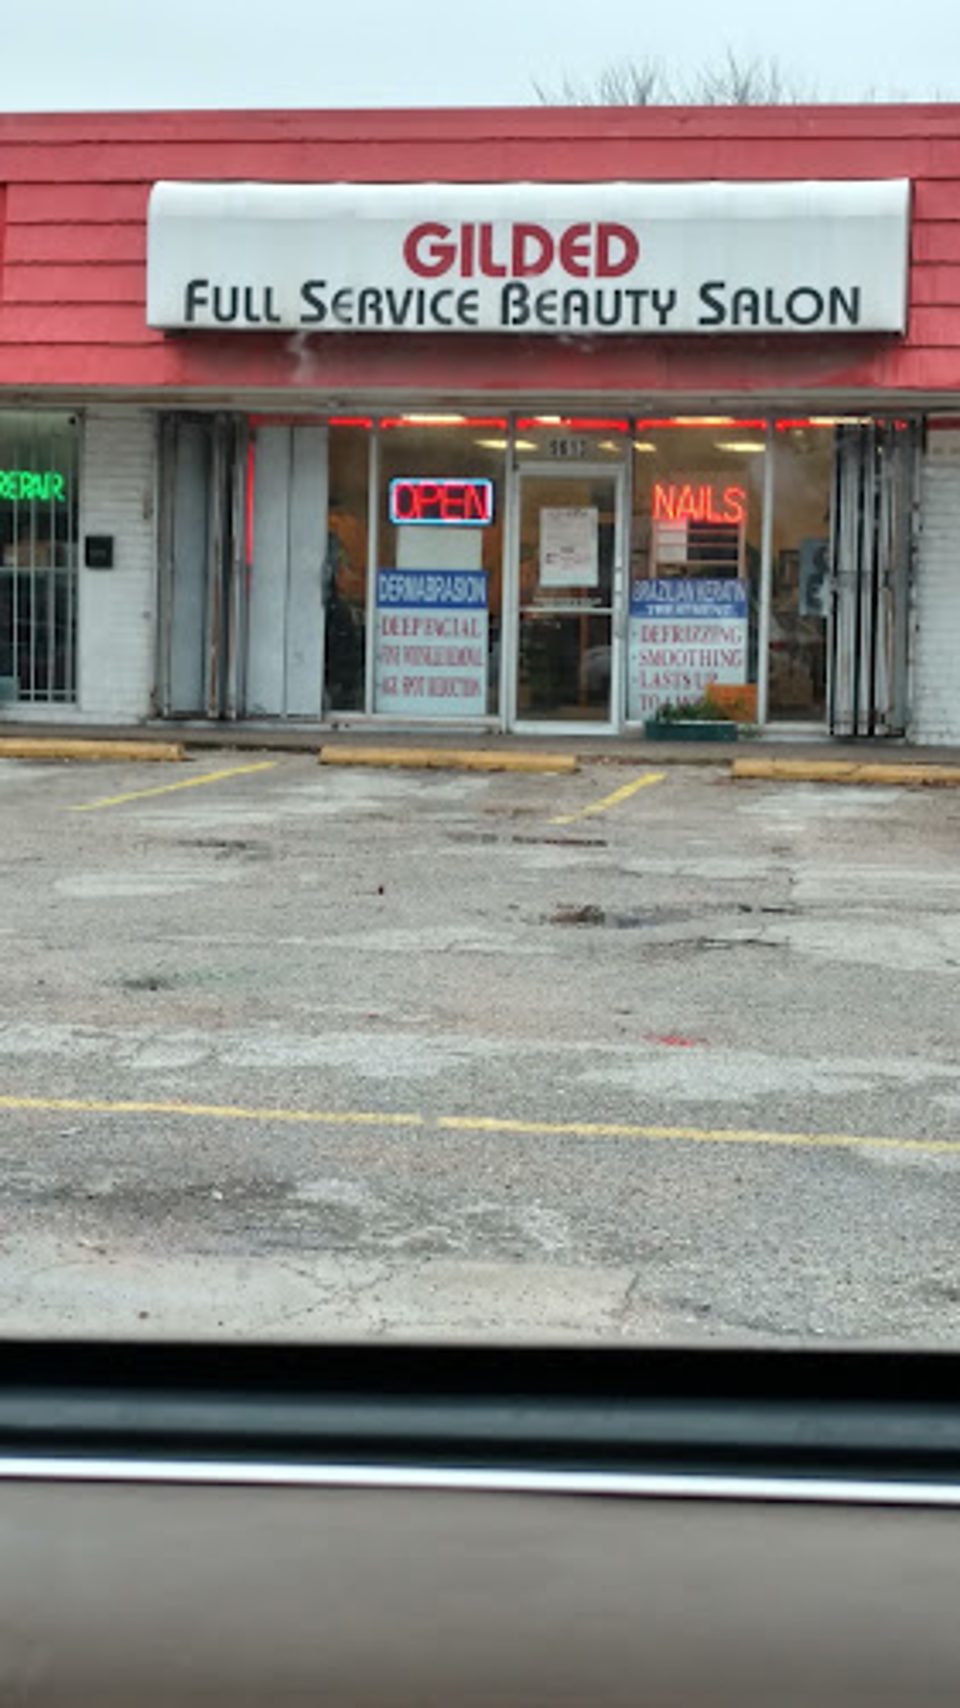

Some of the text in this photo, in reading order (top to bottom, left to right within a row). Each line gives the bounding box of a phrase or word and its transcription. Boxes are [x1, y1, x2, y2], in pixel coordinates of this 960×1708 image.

[403, 222, 640, 278] GILDED
[184, 279, 861, 326] FULL SERVICE BEAUTY SALON
[394, 481, 488, 521] OPEN
[653, 484, 746, 524] NAILS
